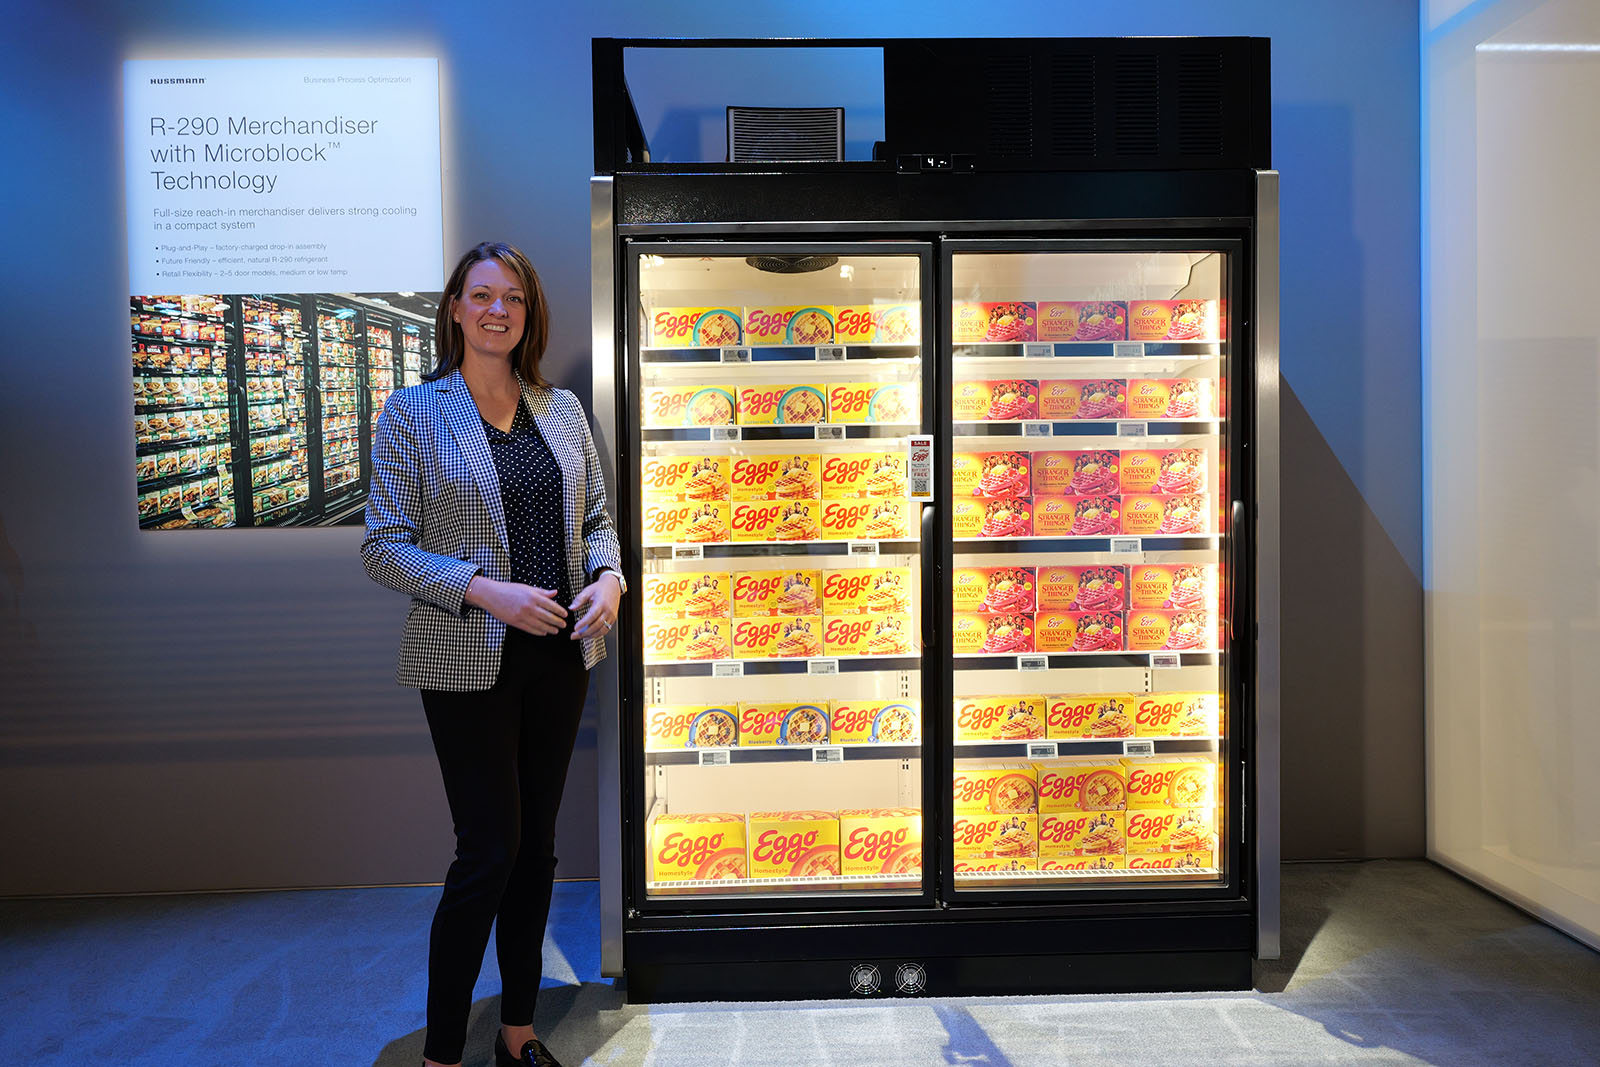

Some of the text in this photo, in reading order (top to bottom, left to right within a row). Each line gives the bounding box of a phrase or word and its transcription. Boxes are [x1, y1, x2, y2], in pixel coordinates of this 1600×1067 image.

[150, 115, 378, 136] R-290 Merchandiser
[150, 144, 195, 163] with
[150, 170, 277, 194] Technology
[153, 206, 417, 217] Full-size reach-in merchandiser delivers strong cooling
[153, 221, 162, 230] in
[174, 222, 217, 231] compact
[220, 221, 256, 231] system
[182, 270, 213, 278] Flexibility
[184, 257, 211, 265] Friendly
[654, 311, 701, 338] Eggo
[745, 310, 796, 336] Eggo
[835, 309, 884, 336] Eggo
[1042, 319, 1074, 328] STRANGER
[1134, 319, 1166, 327] STRANGER
[736, 388, 786, 416] Eggo
[828, 387, 877, 413] Eggo
[954, 398, 986, 407] STRANGER
[1043, 398, 1076, 407] STRANGER
[1132, 396, 1165, 404] STRANGER
[643, 460, 690, 487] Eggo
[731, 459, 780, 486] Eggo
[822, 457, 871, 484] Eggo
[1037, 468, 1069, 477] STRANGER
[1123, 467, 1156, 475] STRANGER
[644, 506, 690, 533] Eggo
[731, 504, 780, 532] Eggo
[822, 503, 870, 530] Eggo
[1038, 513, 1070, 522] STRANGER
[1127, 512, 1159, 520] STRANGER
[646, 578, 690, 605] Eggo
[733, 575, 782, 602] Eggo
[823, 573, 872, 600] Eggo
[1042, 584, 1074, 593] STRANGER
[1135, 582, 1168, 591] STRANGER
[646, 624, 690, 650] Eggo
[733, 621, 782, 648] Eggo
[824, 619, 873, 646] Eggo
[1040, 629, 1072, 638] STRANGER
[1132, 628, 1165, 636] STRANGER
[650, 711, 699, 738] Eggo
[739, 708, 789, 735] Eggo
[831, 706, 880, 734] Eggo
[958, 704, 1006, 730] Eggo
[1047, 702, 1096, 729] Eggo
[1136, 700, 1184, 727] Eggo
[953, 776, 998, 802] Eggo
[1039, 773, 1090, 800] Eggo
[1127, 769, 1177, 796] Eggo
[953, 819, 998, 845] Eggo
[1039, 817, 1088, 843] Eggo
[1127, 813, 1174, 840] Eggo
[658, 832, 725, 868] Eggo
[753, 829, 819, 865] Eggo
[843, 826, 909, 862] Eggo
